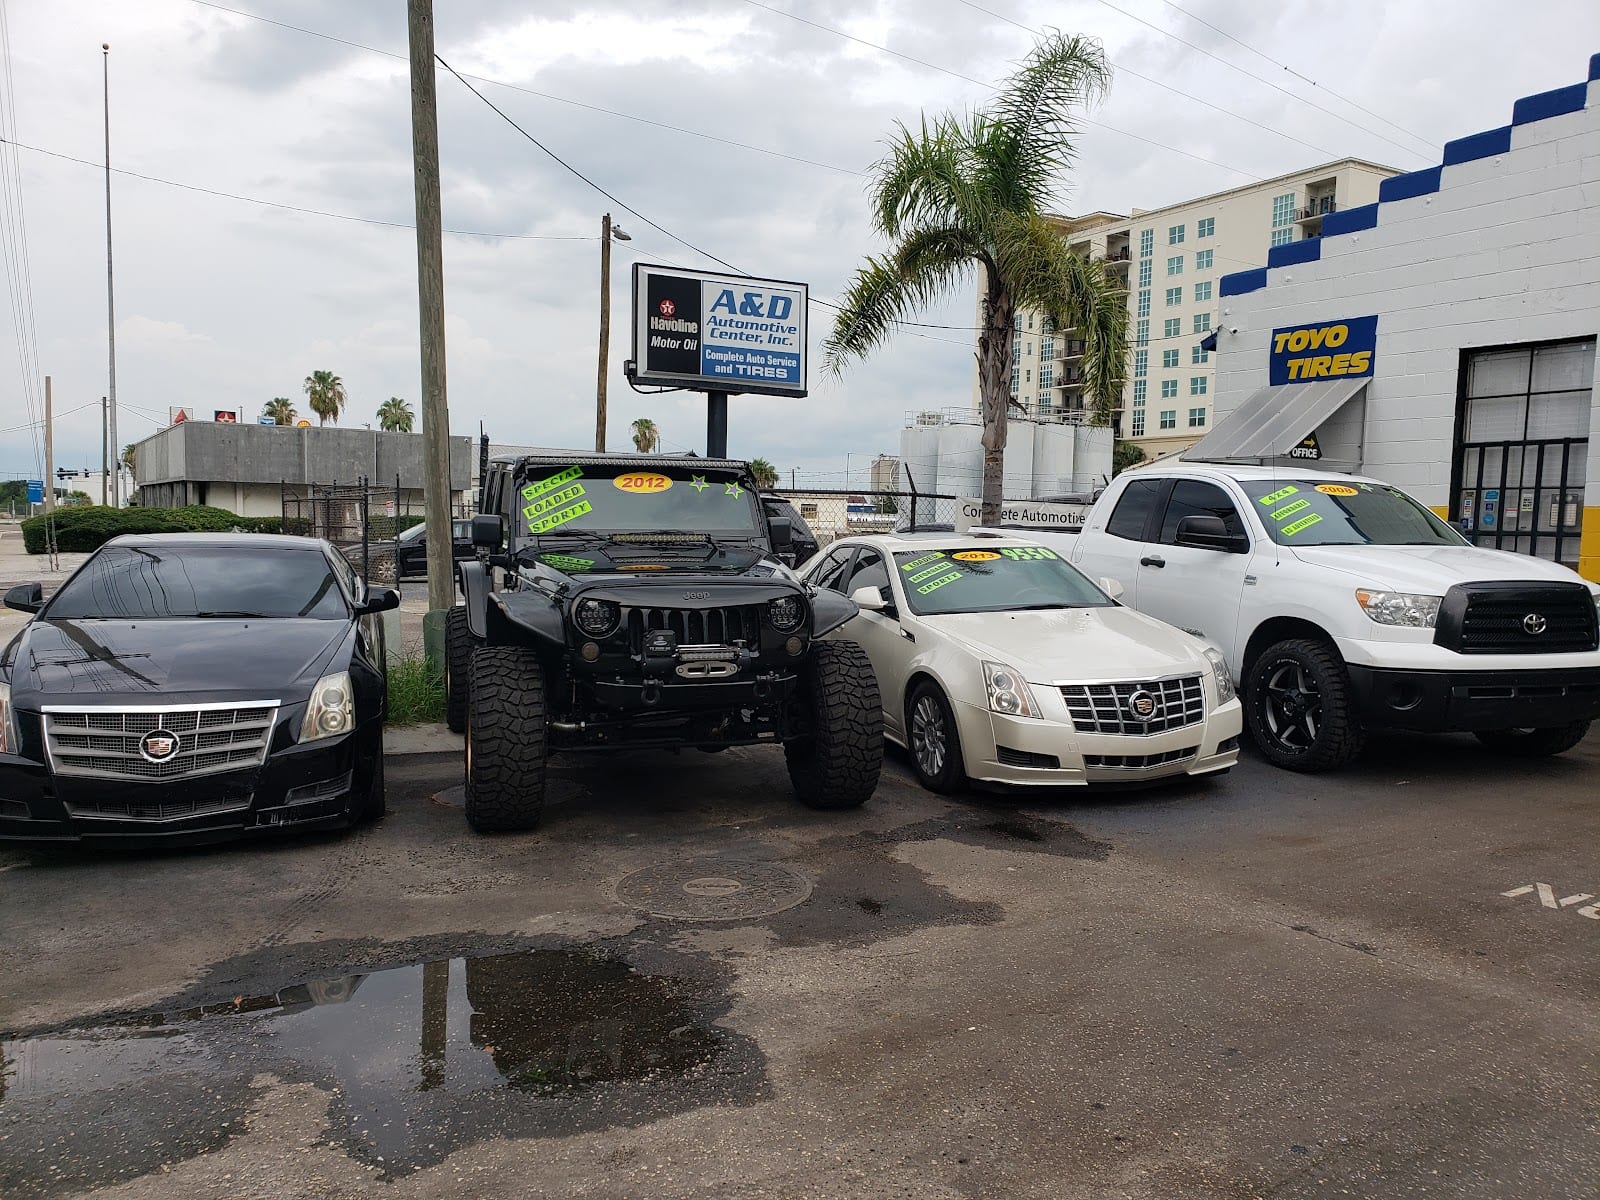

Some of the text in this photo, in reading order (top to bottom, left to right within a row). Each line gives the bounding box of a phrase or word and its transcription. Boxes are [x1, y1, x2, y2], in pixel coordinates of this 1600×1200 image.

[709, 289, 793, 320] A&D
[650, 316, 698, 334] Havoline
[706, 315, 797, 334] Automotive
[650, 335, 698, 351] Motor Oil
[710, 327, 793, 346] Center, Inc.
[1274, 324, 1349, 354] TOYO
[705, 349, 797, 367] Complete Auto Service
[1286, 350, 1372, 380] TIRES
[715, 364, 788, 379] and TIRES
[1291, 447, 1318, 458] OFFICE
[525, 468, 580, 497] SPECIAL
[621, 477, 665, 488] 2012
[1319, 486, 1353, 494] 2008
[526, 486, 579, 517] LOADED
[532, 502, 587, 532] SPORTY
[1021, 508, 1086, 524] Automotive
[908, 554, 938, 568] LOADED
[919, 572, 957, 593] SPORTY
[681, 591, 711, 600] Jeep
